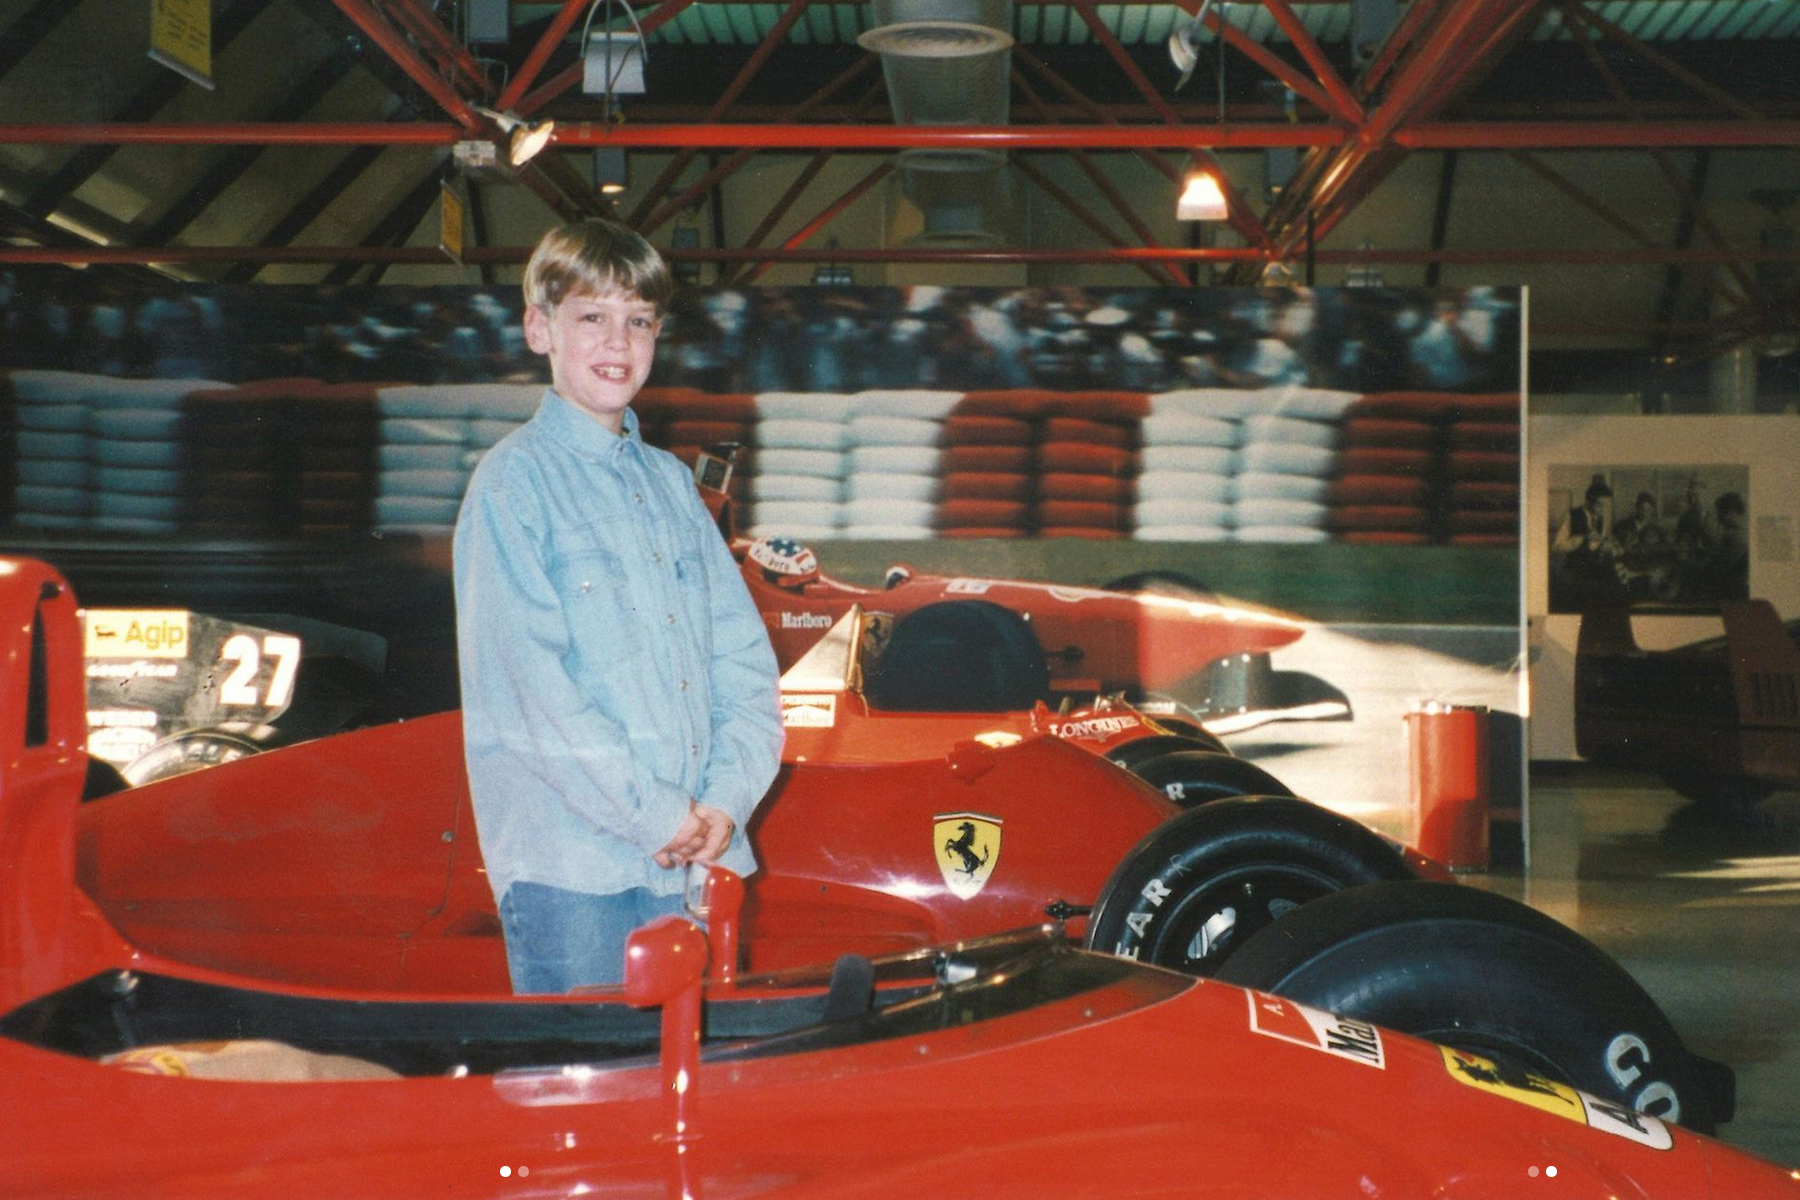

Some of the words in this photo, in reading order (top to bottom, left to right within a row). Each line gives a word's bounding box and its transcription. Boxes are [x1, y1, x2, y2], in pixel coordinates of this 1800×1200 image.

[125, 620, 184, 650] Agip
[782, 612, 832, 628] Marlboro
[220, 634, 301, 706] 27
[1605, 1033, 1680, 1123] GO
